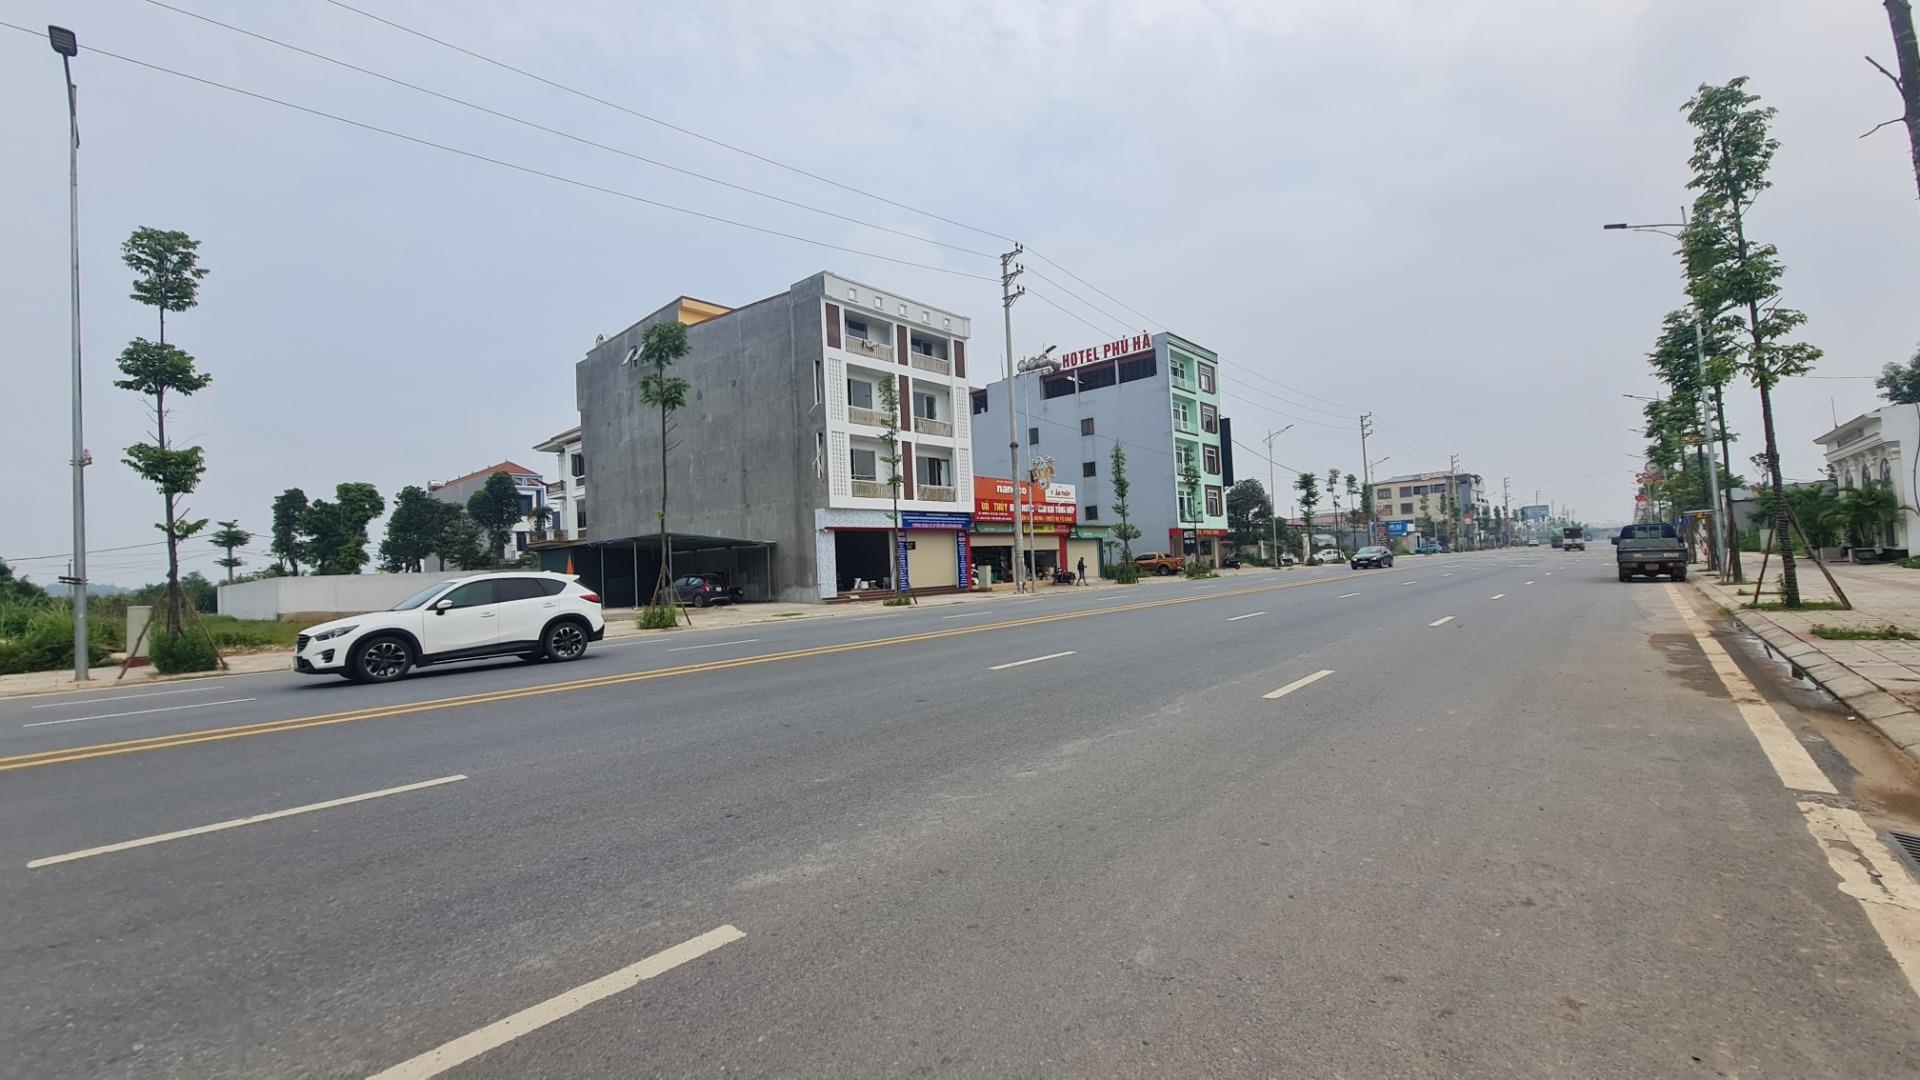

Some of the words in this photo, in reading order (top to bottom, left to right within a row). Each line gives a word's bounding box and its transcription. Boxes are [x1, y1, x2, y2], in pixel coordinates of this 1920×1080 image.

[1063, 347, 1099, 369] HOTEL
[1104, 335, 1129, 358] PHÚ
[1133, 329, 1151, 351] HÀ
